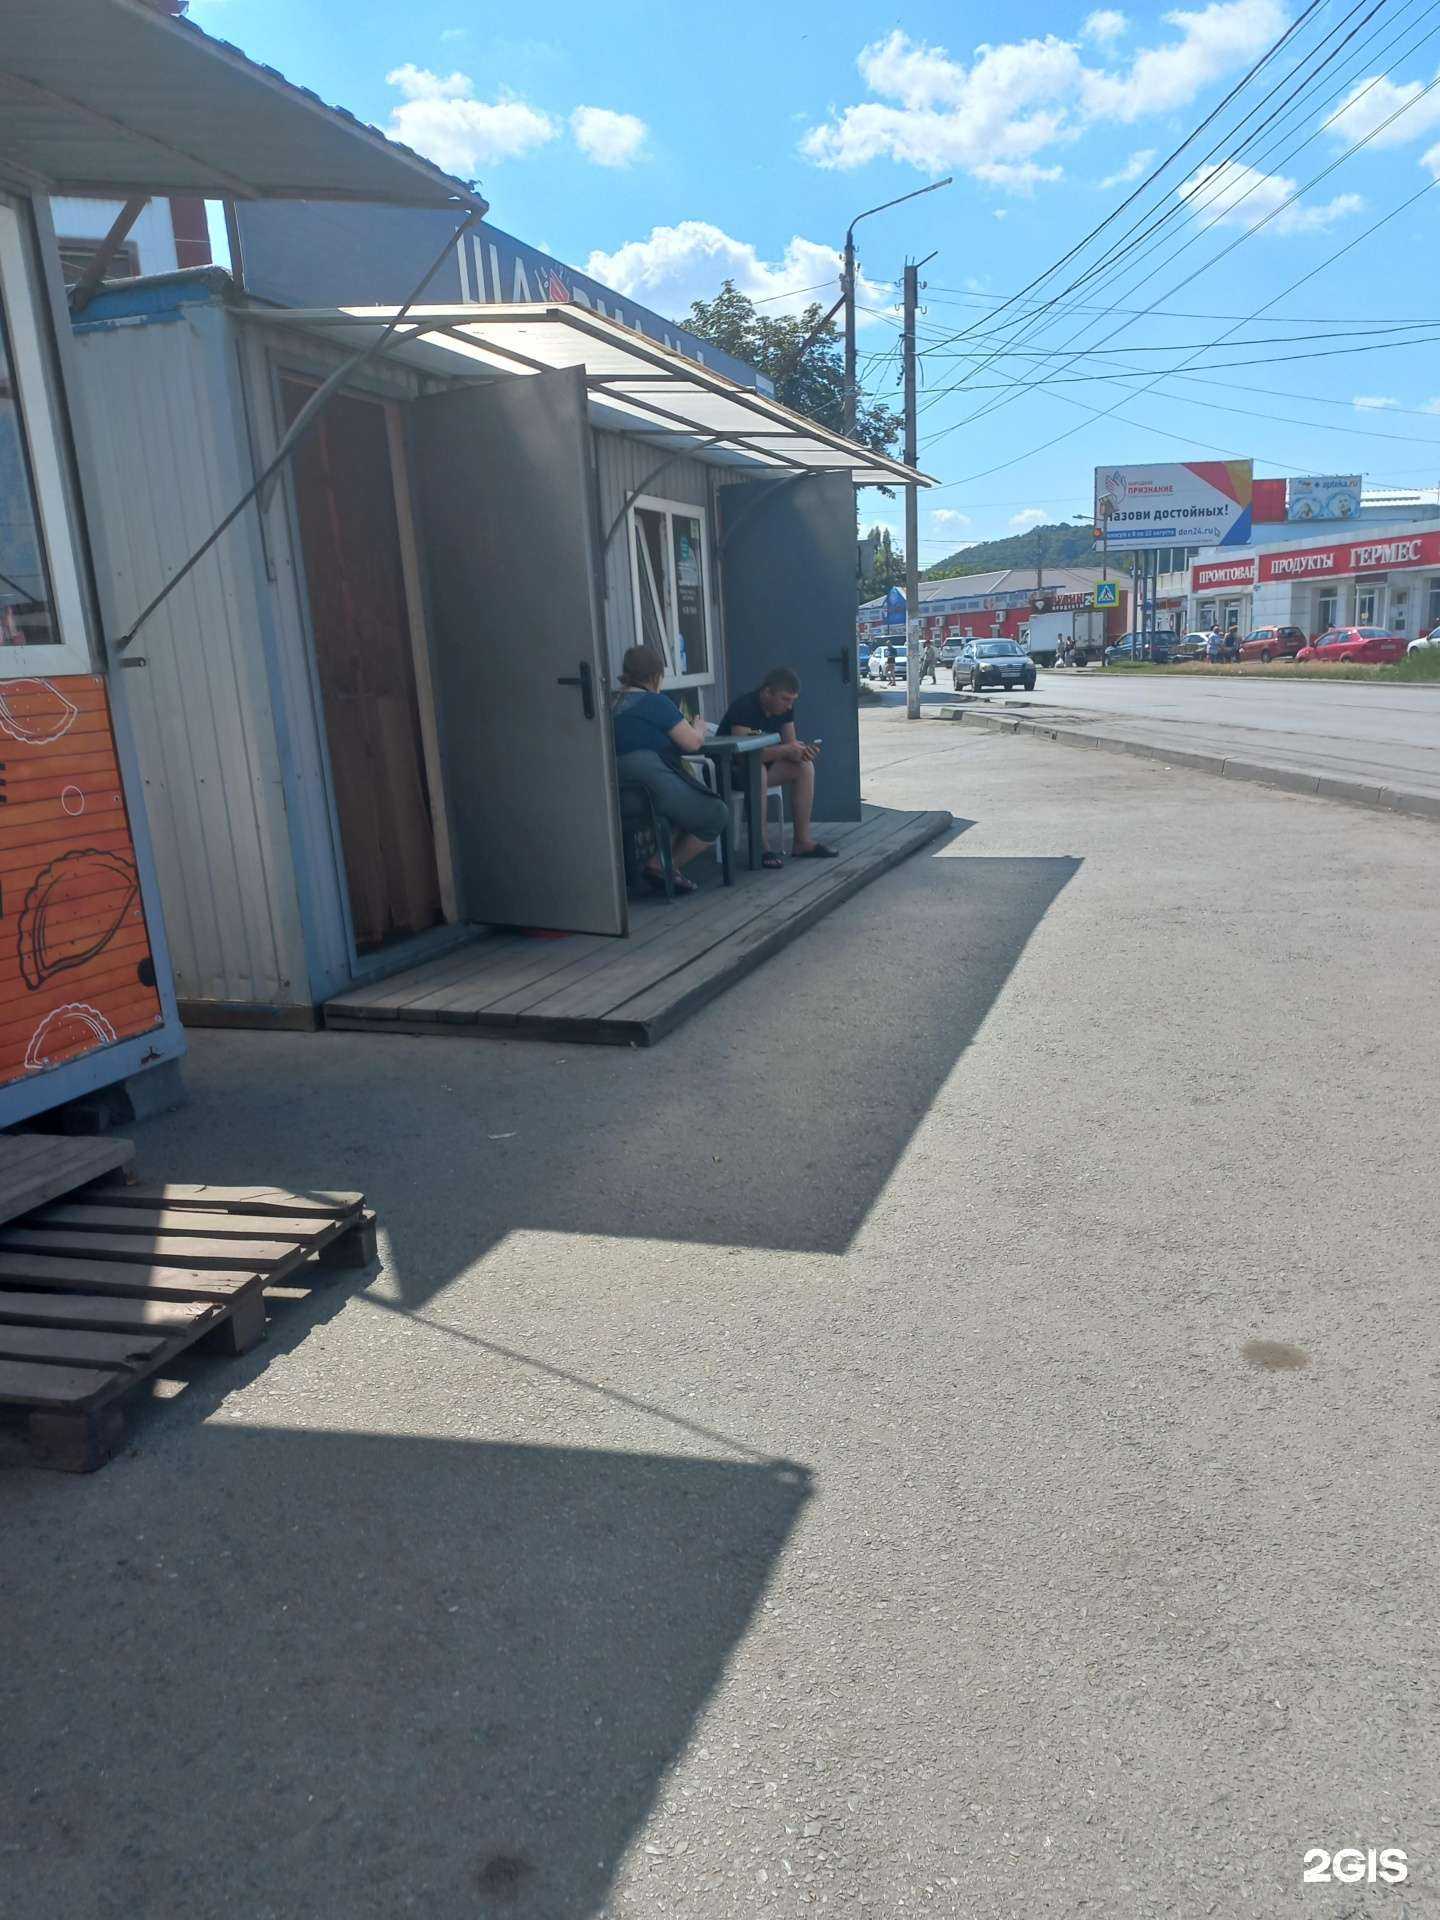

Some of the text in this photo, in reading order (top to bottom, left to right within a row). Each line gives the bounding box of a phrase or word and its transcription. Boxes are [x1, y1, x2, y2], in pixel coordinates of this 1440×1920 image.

[1154, 504, 1229, 521] достойных!
[1270, 539, 1423, 574] ПРОДУКТЫ ГЕРМЕС
